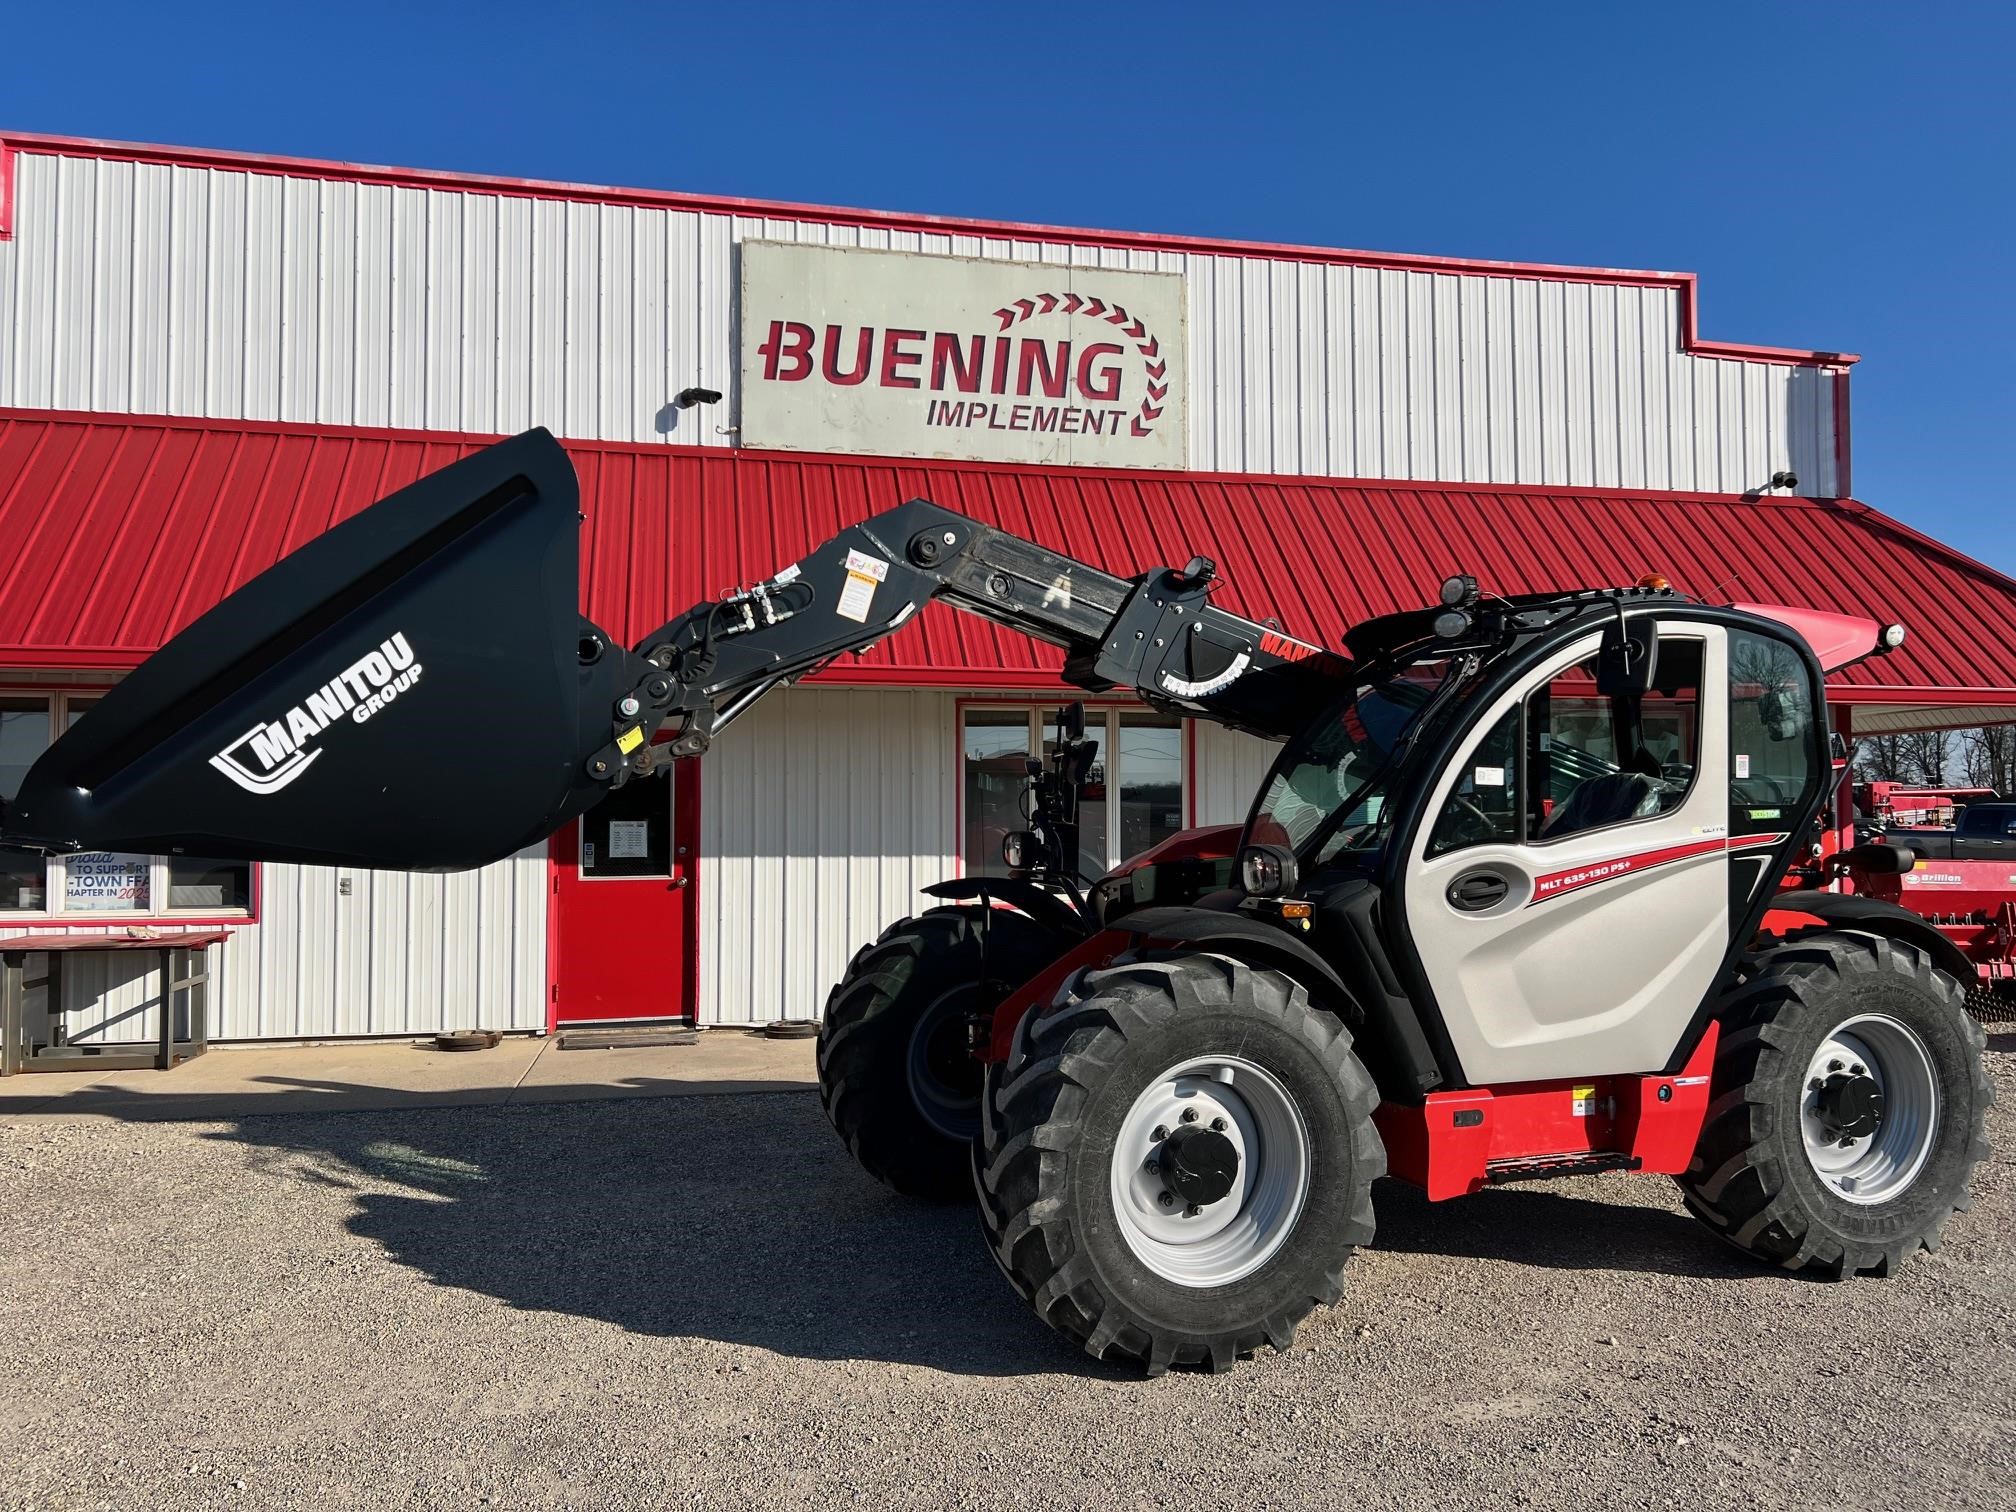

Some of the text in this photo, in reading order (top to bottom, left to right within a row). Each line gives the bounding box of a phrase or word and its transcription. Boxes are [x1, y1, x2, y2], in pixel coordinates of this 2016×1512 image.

[757, 319, 1124, 401] BUENING
[926, 399, 1128, 436] IMPLEMENT
[249, 631, 414, 770] MANITOU
[352, 663, 423, 724] GROUP
[66, 875, 122, 887] -TOWN
[76, 865, 93, 874] TO
[1540, 861, 1631, 892] MLT 635-130 PS+
[1921, 874, 1961, 883] Brillion
[66, 887, 150, 900] HAPTER IN 2025
